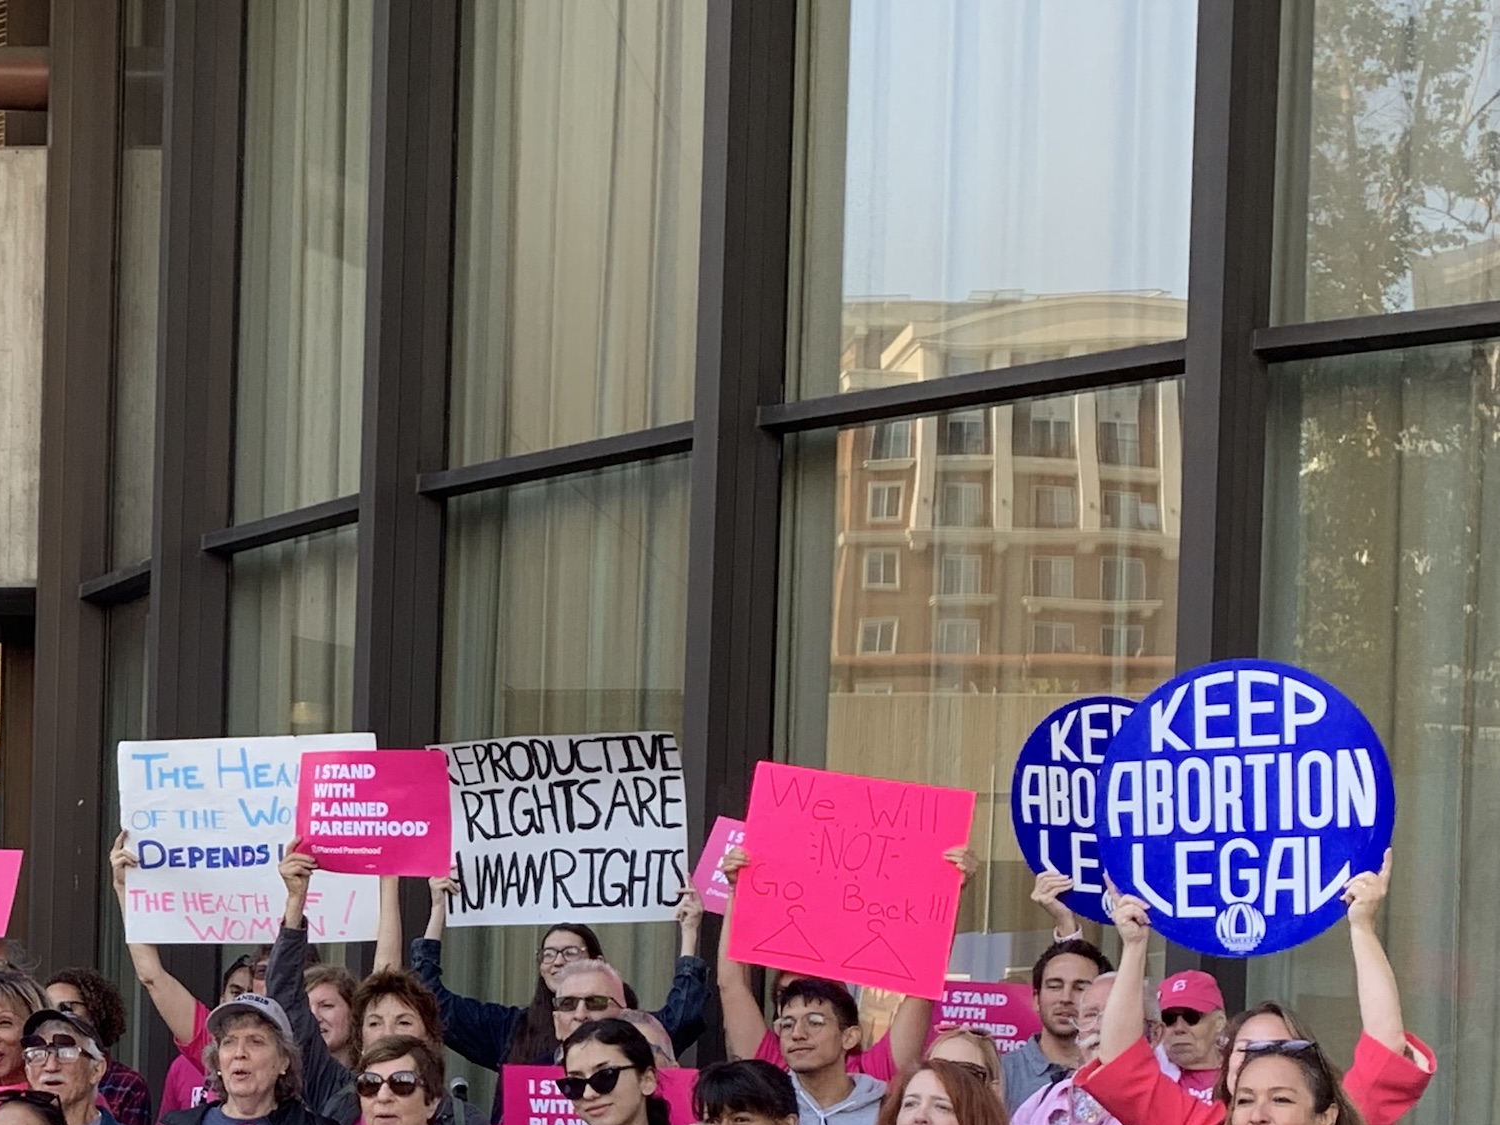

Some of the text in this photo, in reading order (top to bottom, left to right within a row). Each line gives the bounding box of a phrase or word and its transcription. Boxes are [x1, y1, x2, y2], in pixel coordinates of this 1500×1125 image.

[1150, 669, 1327, 753] KEEP
[314, 763, 376, 780] I STAND
[430, 734, 682, 786] EPRODUCTIVE
[314, 783, 356, 799] WITH
[770, 769, 939, 833] We Will
[1107, 748, 1377, 838] ABORTION
[177, 809, 227, 830] THE
[311, 802, 389, 818] PLANNED
[462, 776, 683, 842] RIGHTS ARE
[310, 821, 429, 837] PARENTHOOD
[137, 840, 270, 870] DEPENDS
[819, 826, 895, 878] NOT
[550, 848, 686, 908] RIGHTS
[1132, 836, 1351, 918] LEGAL
[129, 889, 175, 913] THE
[182, 892, 269, 915] HEALTH
[843, 884, 919, 924] Back
[184, 915, 326, 941] WOMN
[952, 991, 1008, 1006] STAND
[942, 1006, 987, 1020] WITH
[529, 1080, 535, 1094] I
